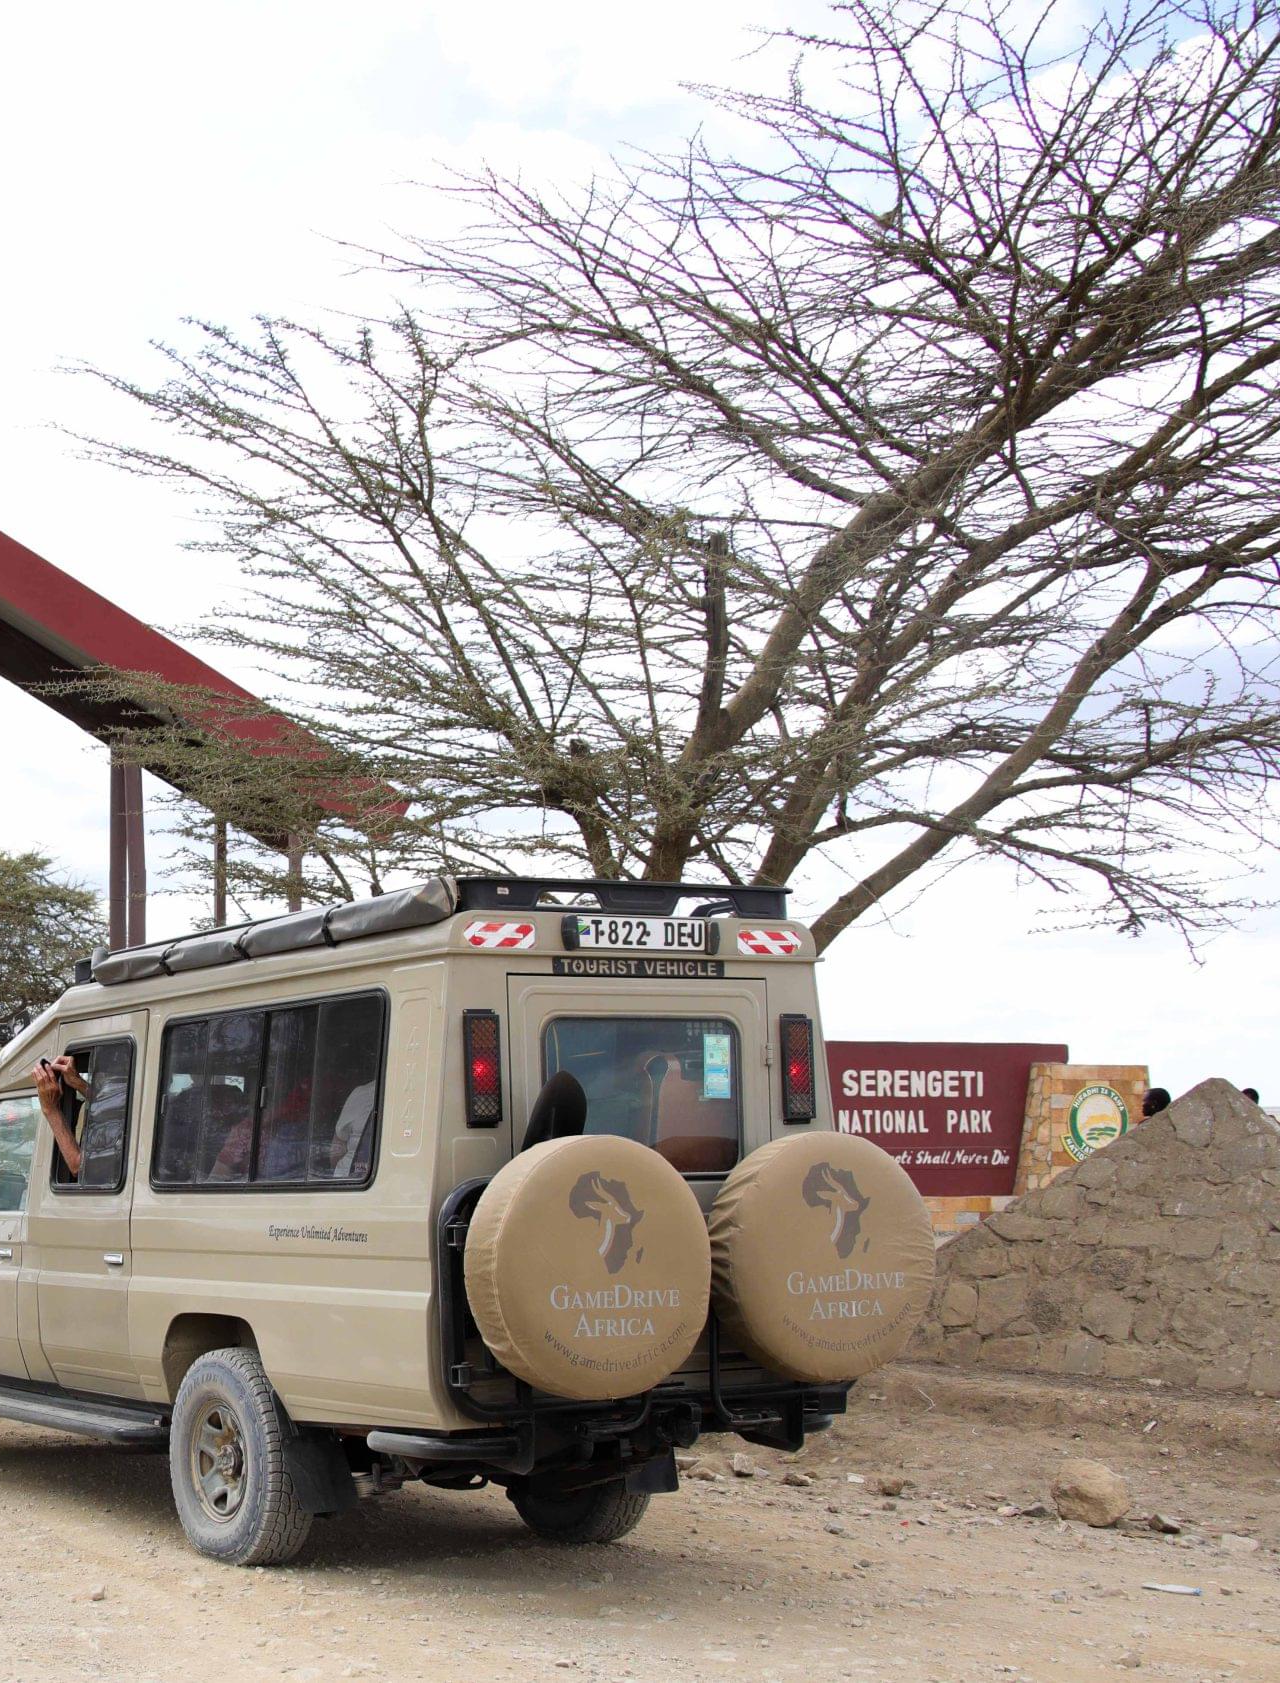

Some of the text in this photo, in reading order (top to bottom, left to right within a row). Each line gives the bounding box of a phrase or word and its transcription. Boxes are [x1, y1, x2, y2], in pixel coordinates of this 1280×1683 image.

[591, 919, 703, 948] T 822 DEU
[560, 958, 717, 977] TOURIST VEHICLE
[842, 1069, 984, 1098] SERENGETI
[1073, 1088, 1099, 1109] HIFADHI
[1100, 1087, 1108, 1095] ZA
[838, 1109, 992, 1134] NATIONAL PARK
[915, 1150, 950, 1165] Shall
[951, 1149, 988, 1165] Never
[991, 1149, 1010, 1165] Die
[1080, 1142, 1095, 1153] TAN
[268, 1225, 368, 1242] Experience Unlimited Adventures
[808, 1298, 884, 1320] AFRICA
[574, 1313, 656, 1338] AFRICA
[782, 1301, 912, 1352] www.gamedriveafrica.com
[544, 1321, 688, 1372] www.gamedriveafrica.com
